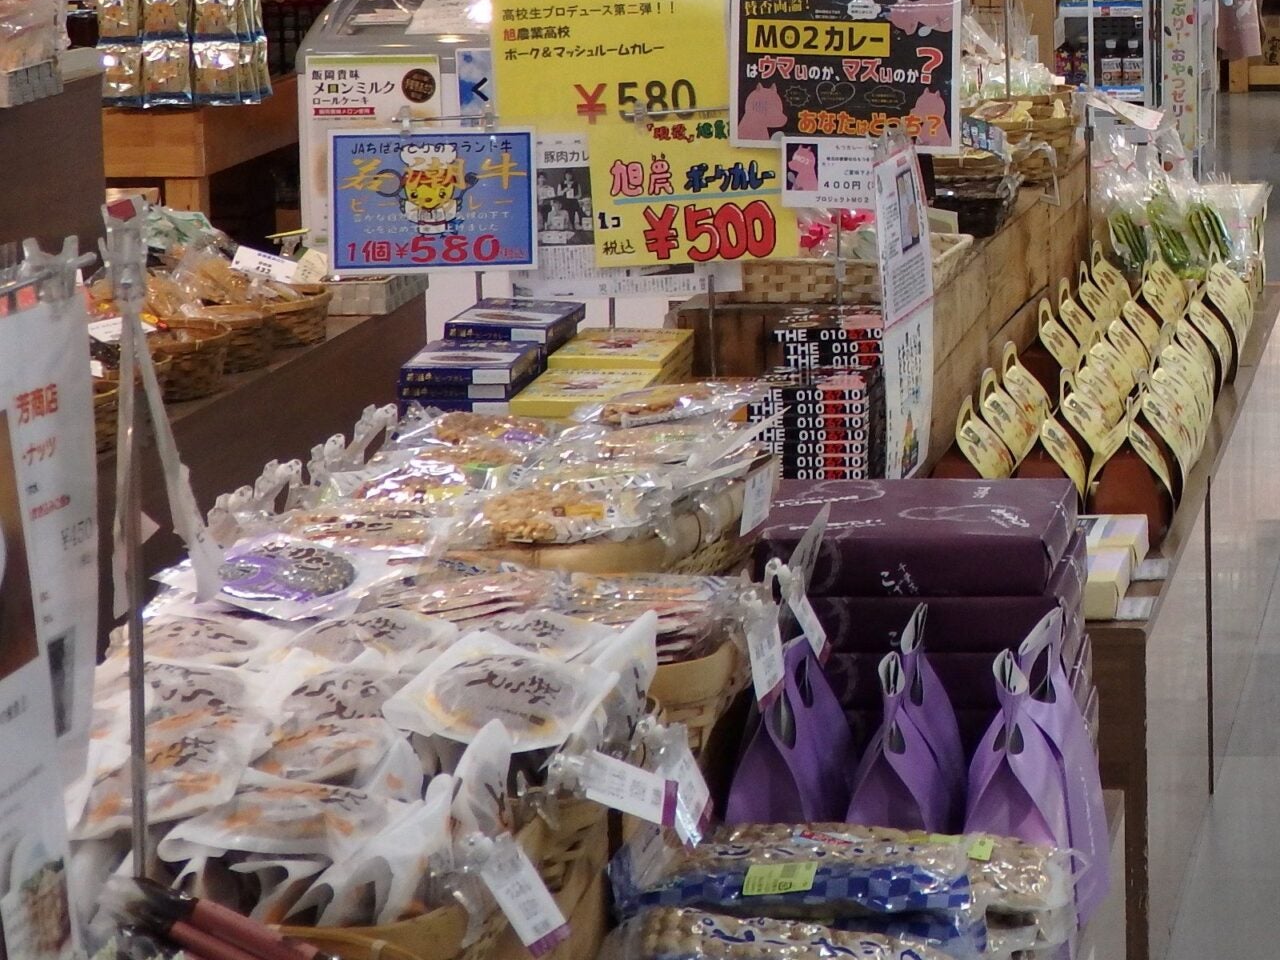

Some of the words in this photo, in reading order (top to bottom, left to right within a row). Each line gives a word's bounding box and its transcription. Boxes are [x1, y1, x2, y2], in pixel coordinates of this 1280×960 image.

[502, 1, 675, 22] 高校生プロデュース第二弾！！
[504, 25, 571, 41] 旭農業高校
[312, 69, 360, 81] 飯岡貴味
[313, 81, 396, 95] メロンミルク
[312, 96, 369, 105] ロールケーキ
[643, 199, 776, 262] ¥500
